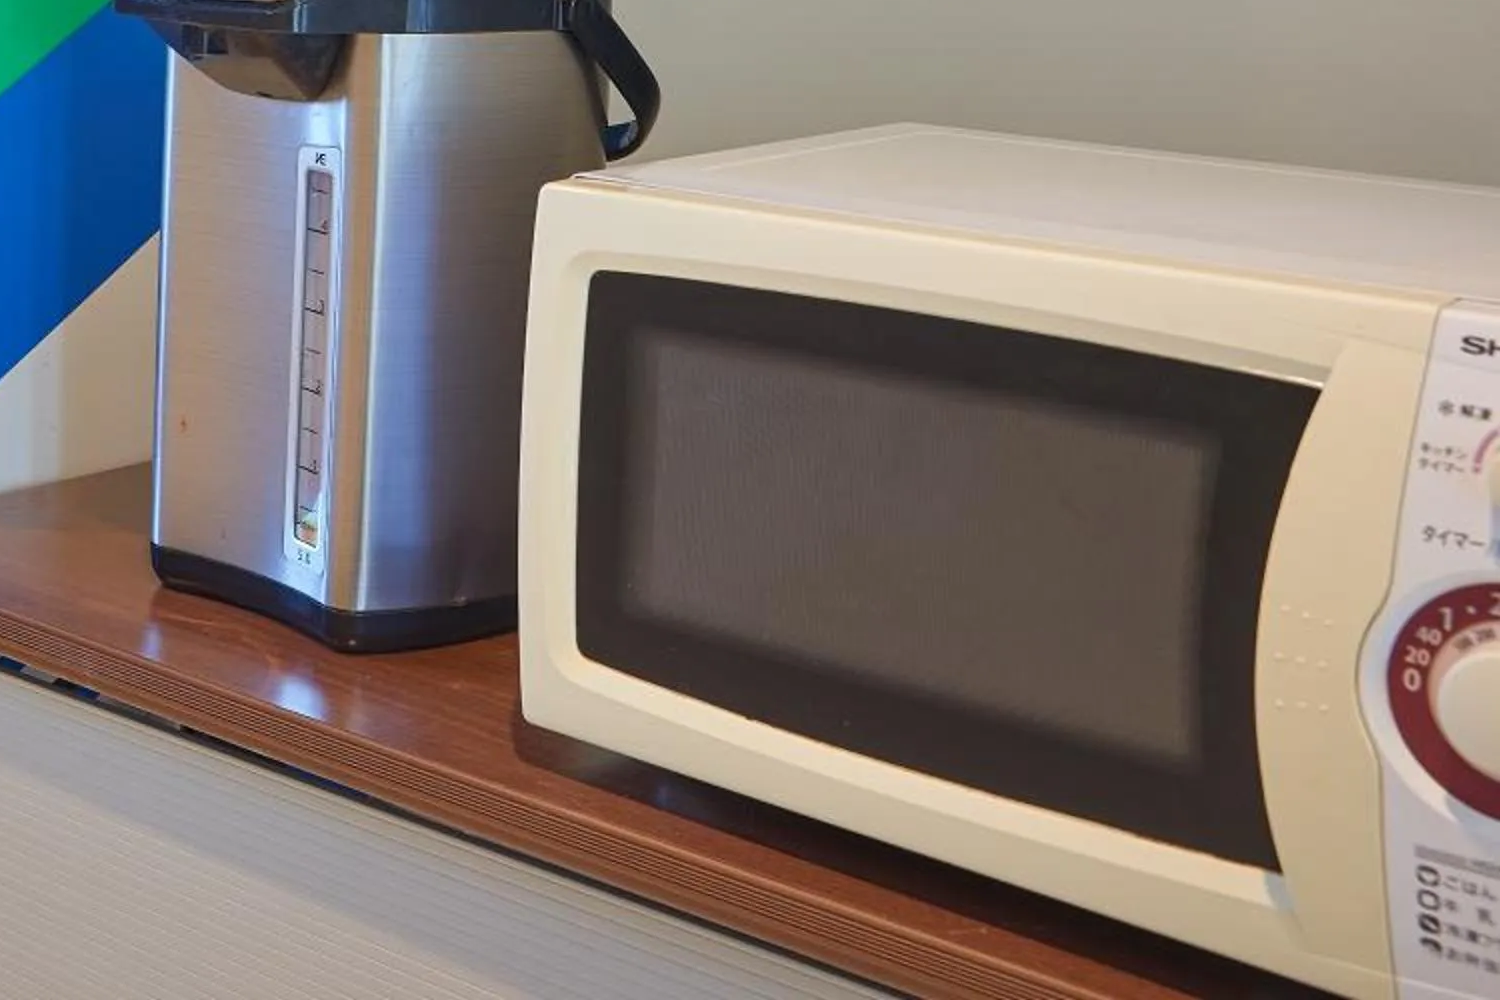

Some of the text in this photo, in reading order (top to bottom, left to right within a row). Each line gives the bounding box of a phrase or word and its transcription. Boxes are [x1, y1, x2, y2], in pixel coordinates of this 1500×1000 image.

[1422, 526, 1486, 549] タイマー
[1403, 667, 1422, 692] 0
